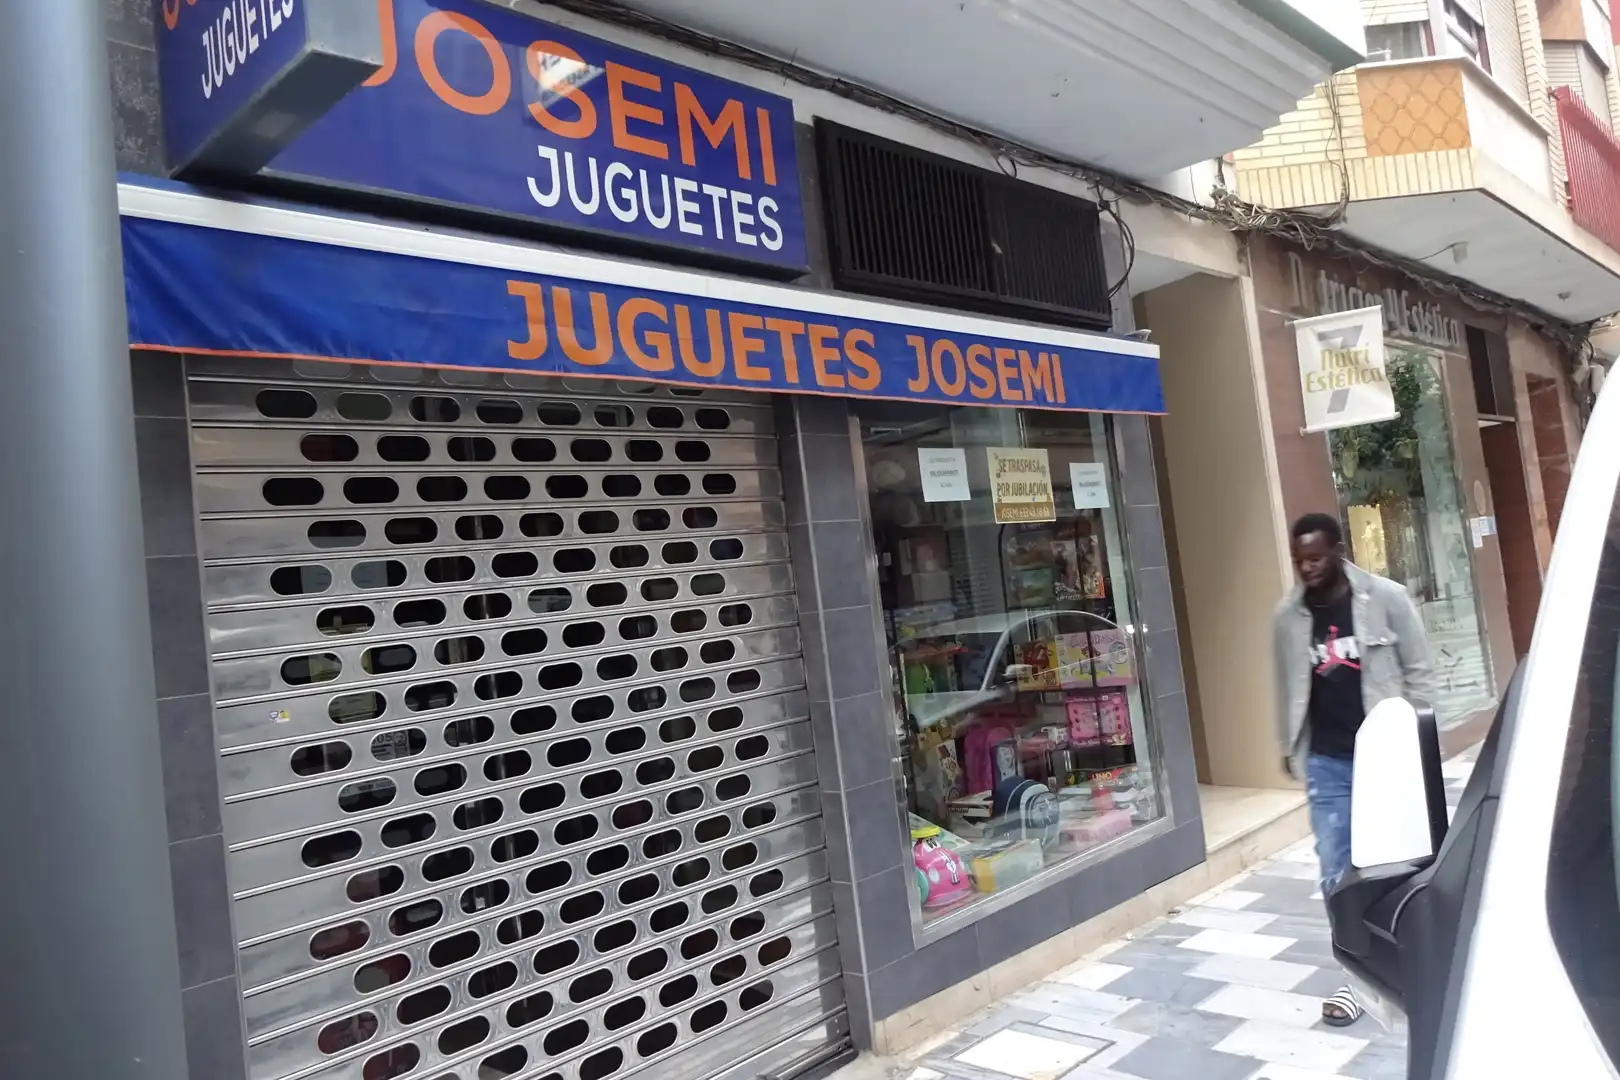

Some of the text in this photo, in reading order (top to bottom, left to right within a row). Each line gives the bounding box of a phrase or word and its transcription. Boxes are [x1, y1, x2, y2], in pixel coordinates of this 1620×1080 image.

[361, 0, 777, 187] JOSEMI
[526, 145, 784, 251] JUGUETES
[506, 280, 1066, 404] JUGUETES JOSEMI
[1305, 367, 1385, 393] Estética
[997, 480, 1048, 497] POR JUBILACIÓN
[1092, 771, 1113, 782] UNO
